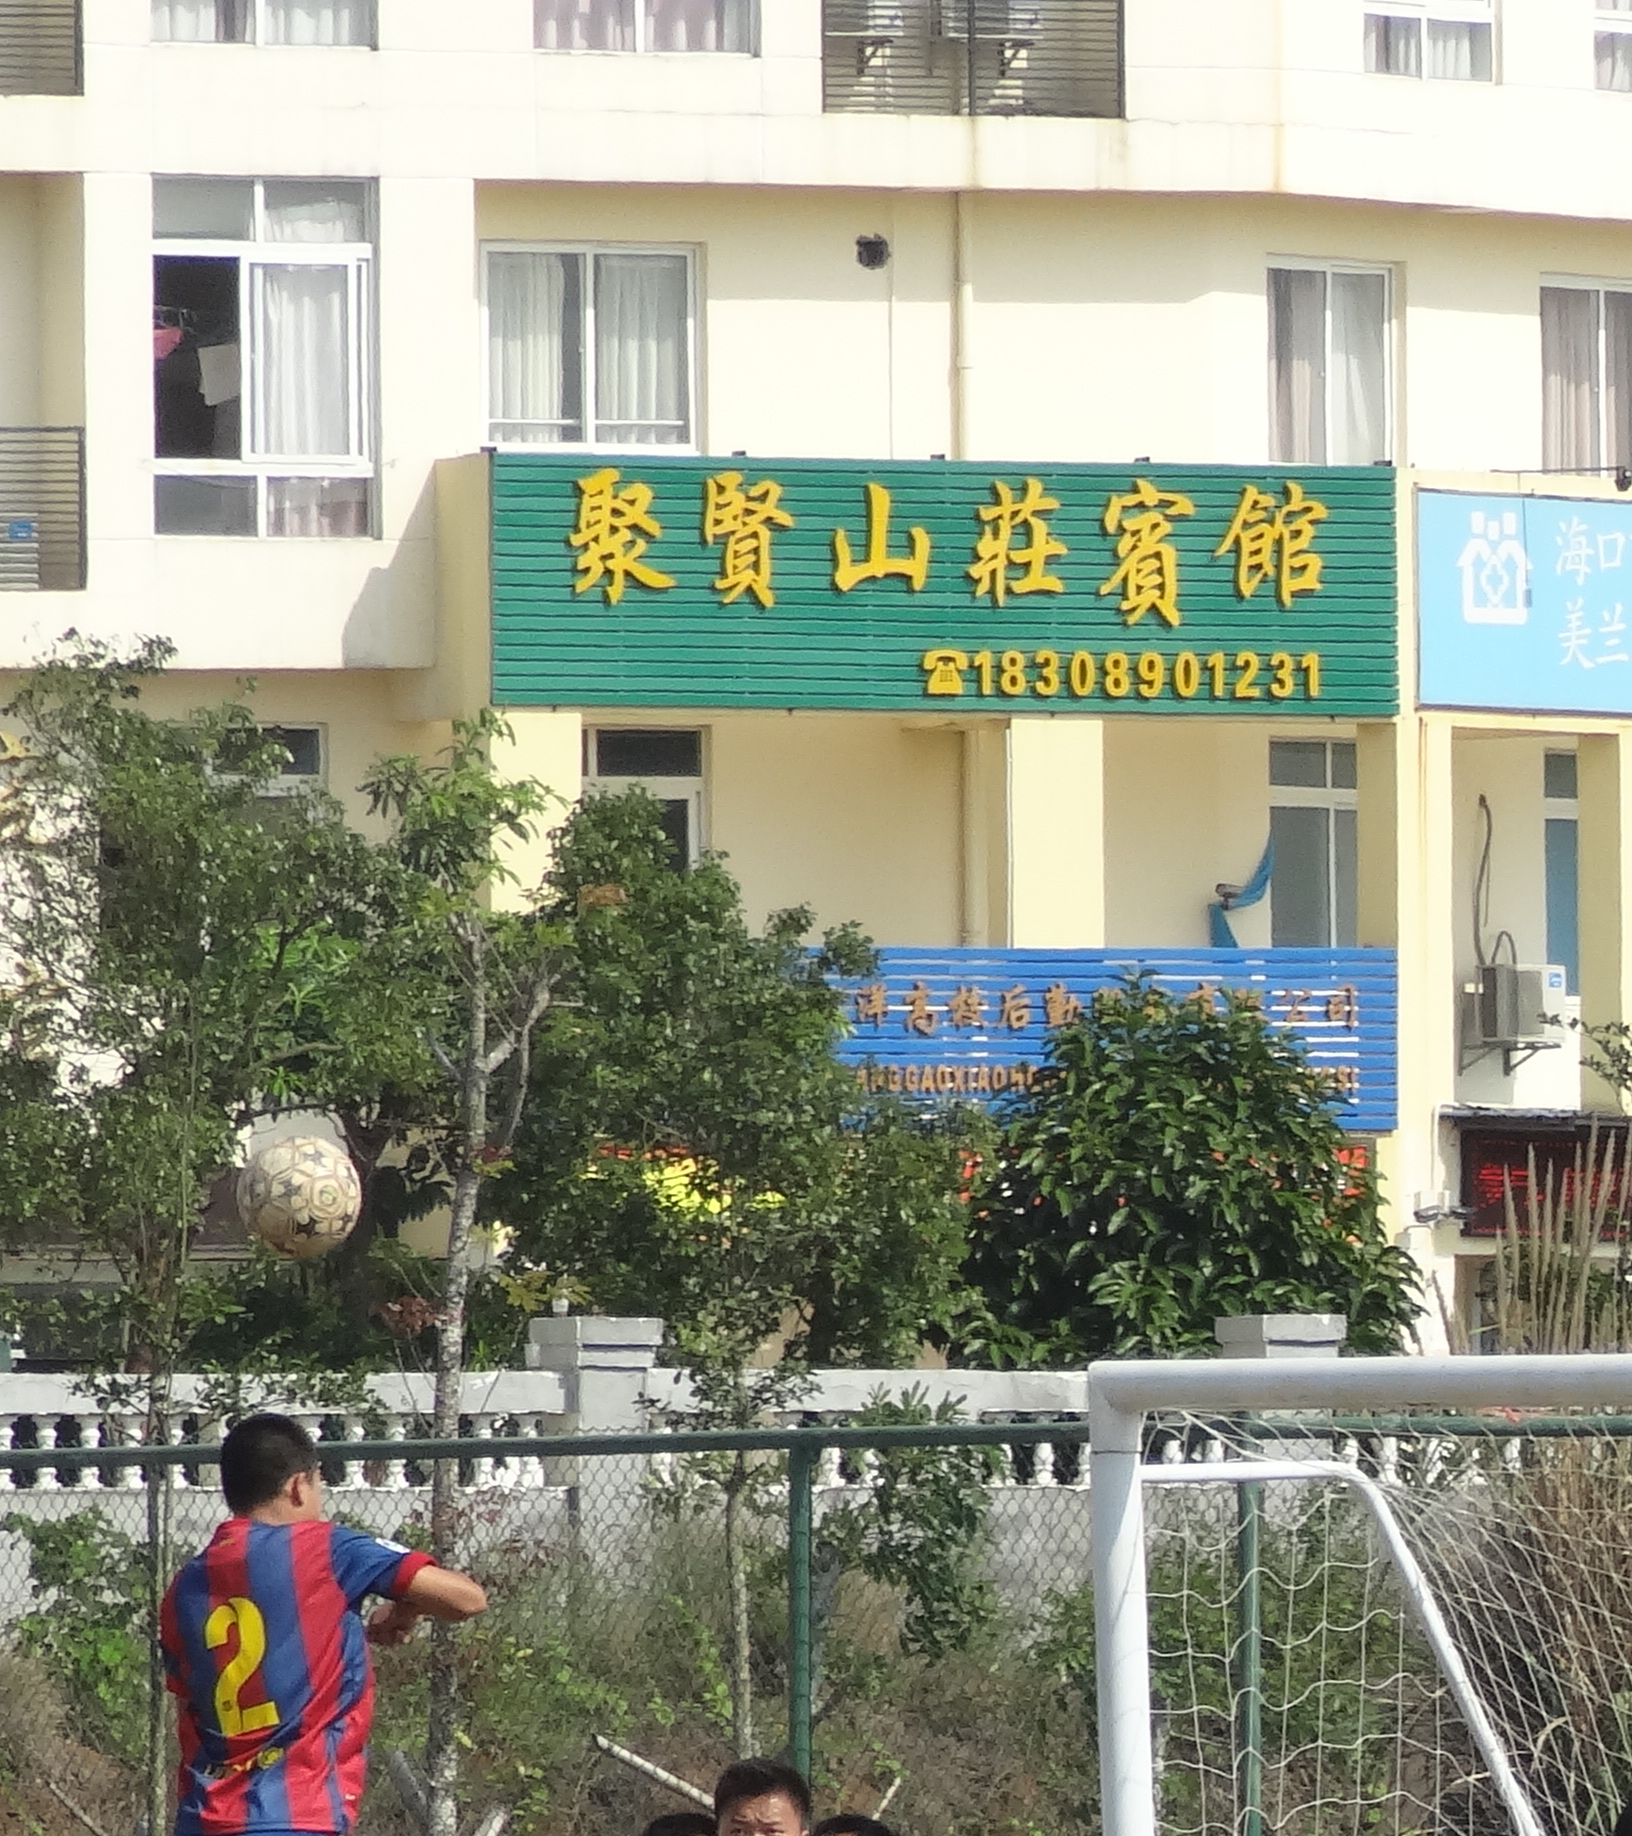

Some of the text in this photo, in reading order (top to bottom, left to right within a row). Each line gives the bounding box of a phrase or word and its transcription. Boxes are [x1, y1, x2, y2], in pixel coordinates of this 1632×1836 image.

[569, 466, 1328, 628] 聚賢山莊賓館
[971, 650, 1324, 701] 18308901231
[204, 1596, 280, 1737] 2
